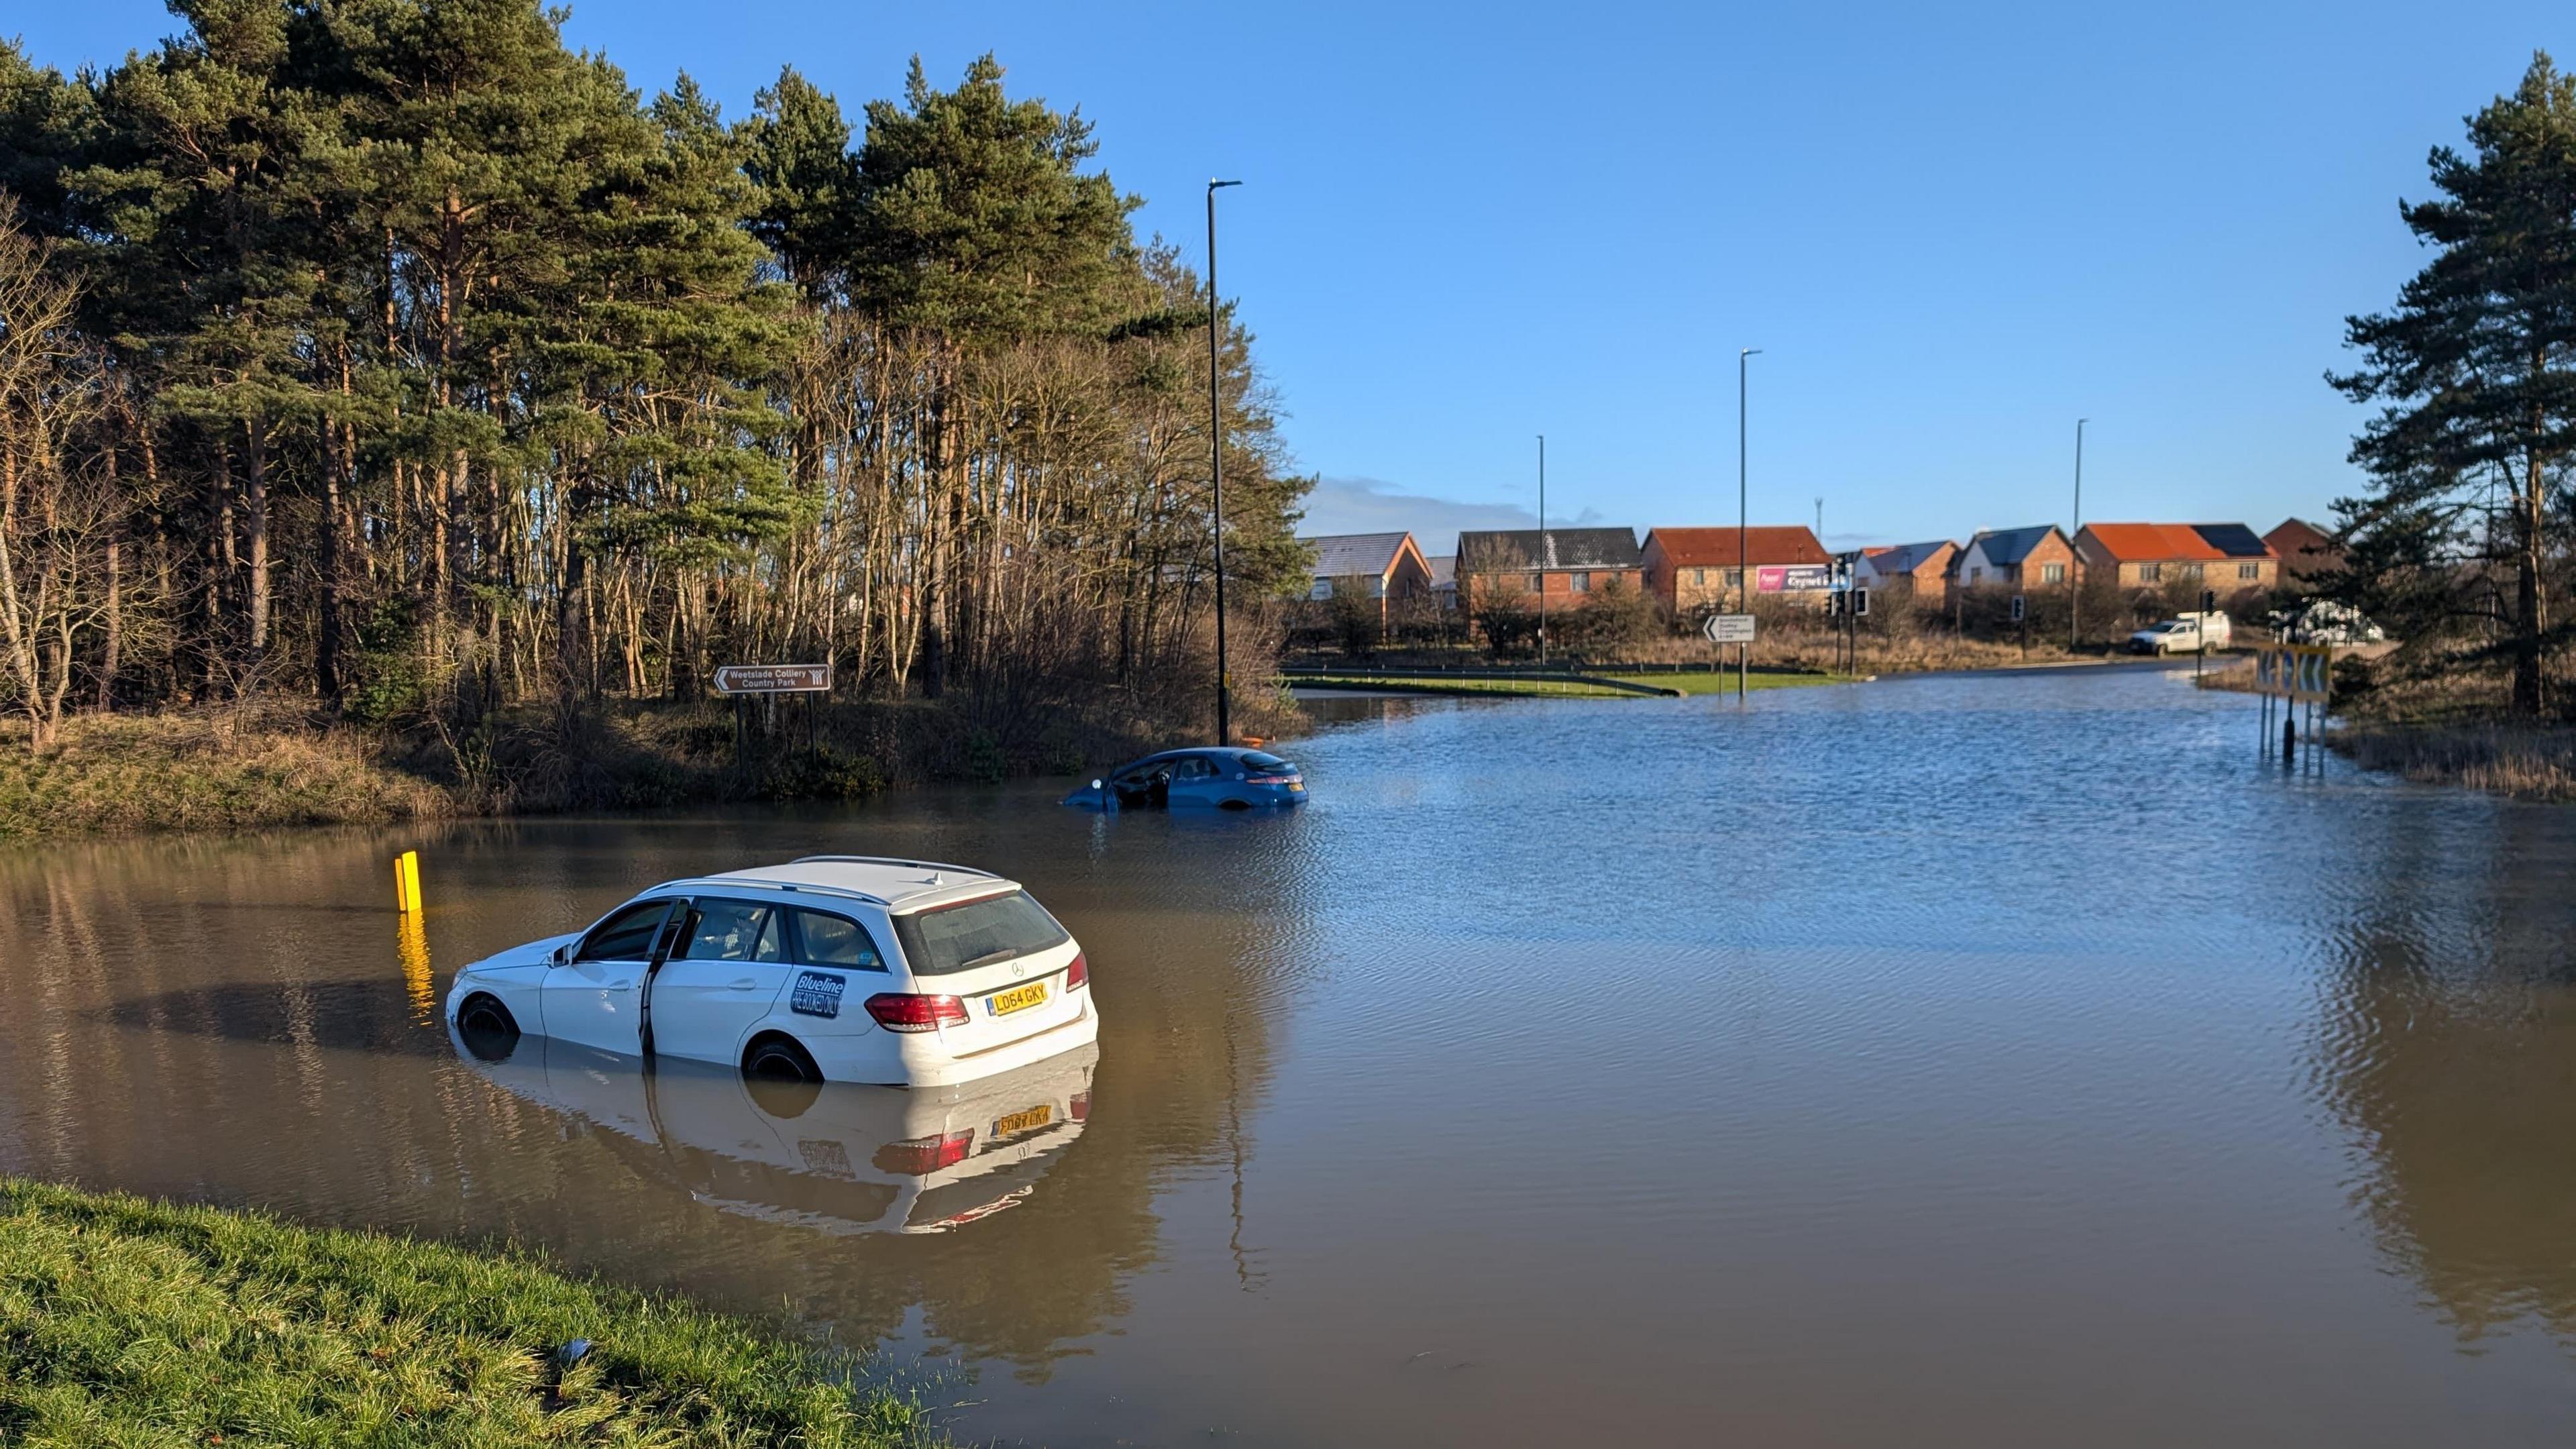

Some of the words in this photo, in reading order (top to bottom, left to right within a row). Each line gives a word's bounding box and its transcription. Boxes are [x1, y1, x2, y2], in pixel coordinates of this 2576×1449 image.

[730, 669, 772, 679] Weetslade
[775, 669, 806, 678] Colliery
[742, 679, 775, 688] Country
[777, 678, 796, 686] Park
[797, 975, 843, 994] Blueline
[1024, 983, 1044, 1002] GKY
